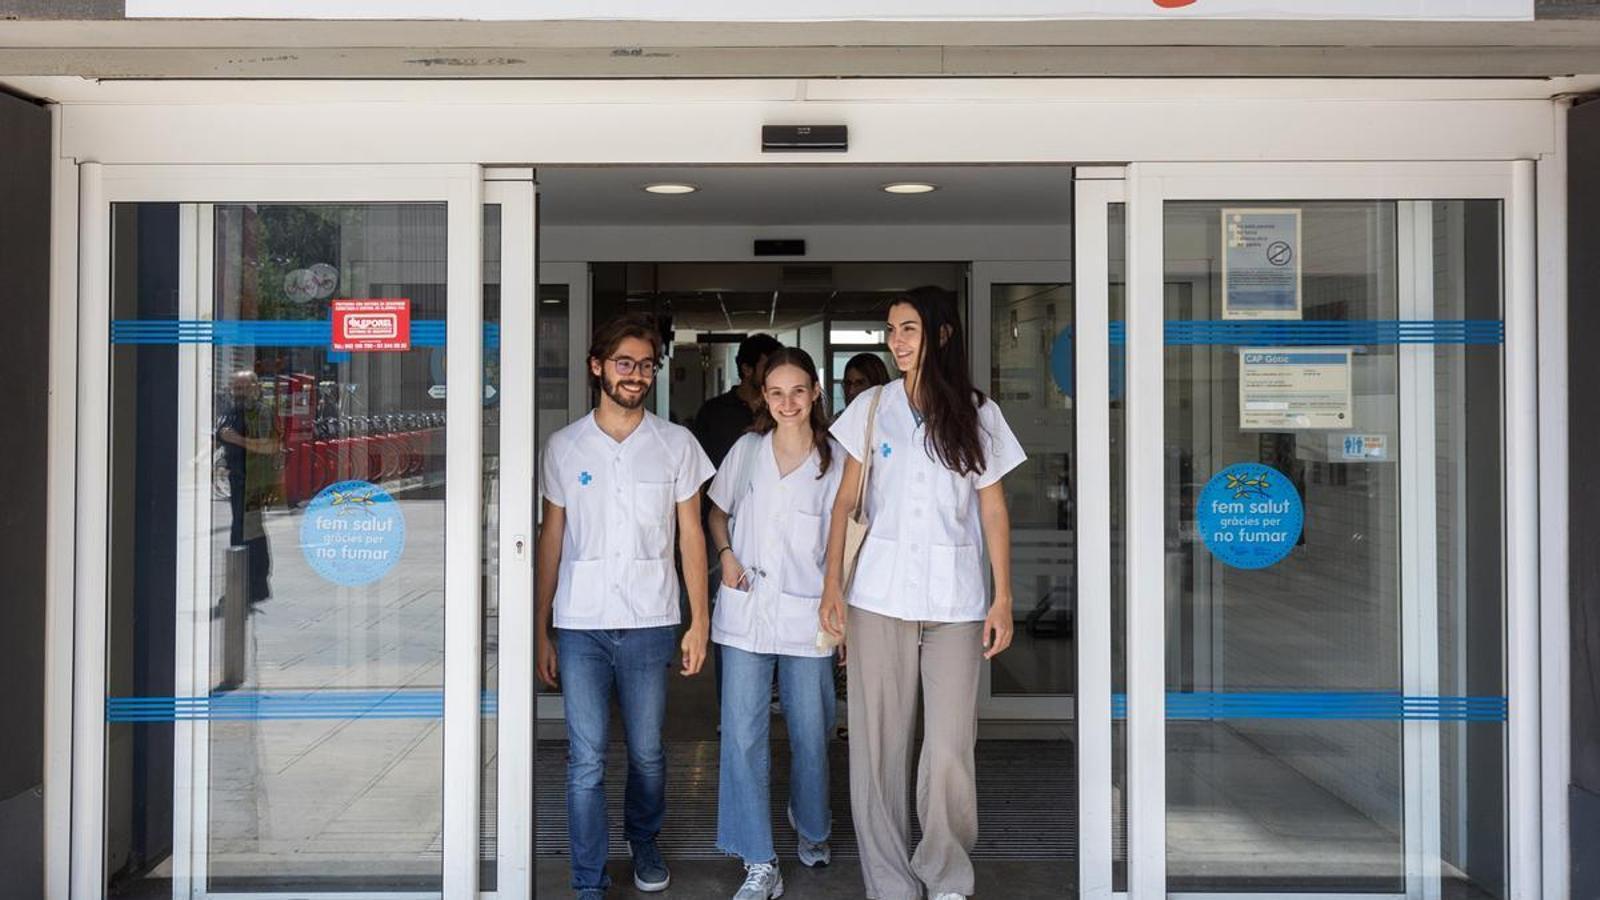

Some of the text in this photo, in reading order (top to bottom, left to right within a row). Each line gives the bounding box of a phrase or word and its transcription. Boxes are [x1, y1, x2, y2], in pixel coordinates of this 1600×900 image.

[1246, 354, 1263, 363] CAP
[1212, 499, 1290, 514] fem salut
[316, 516, 393, 531] fem salut
[1220, 516, 1281, 529] gràcies per
[366, 535, 384, 545] per
[1214, 528, 1287, 542] no fumar
[316, 545, 389, 560] no fumar
